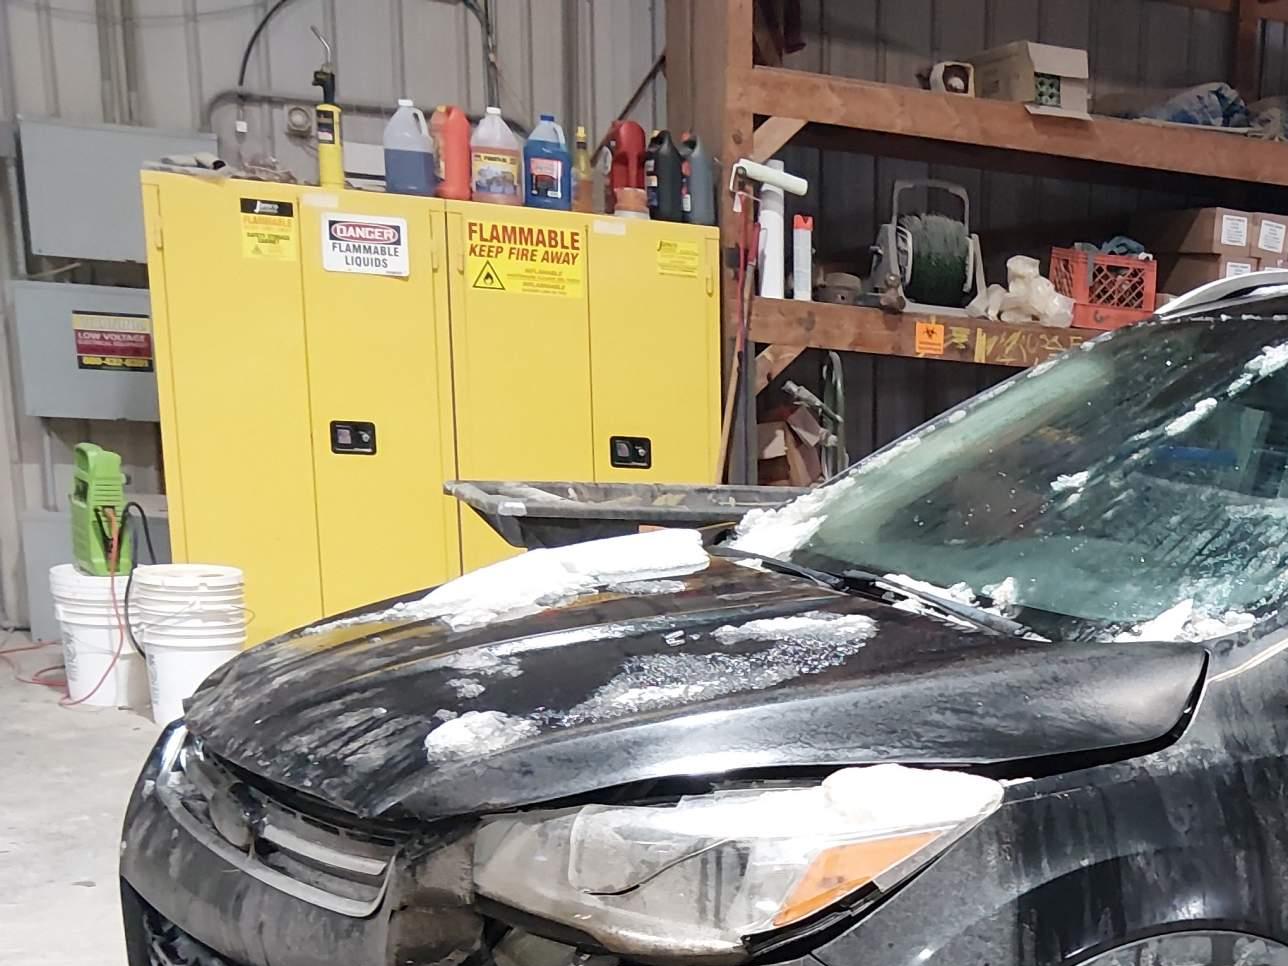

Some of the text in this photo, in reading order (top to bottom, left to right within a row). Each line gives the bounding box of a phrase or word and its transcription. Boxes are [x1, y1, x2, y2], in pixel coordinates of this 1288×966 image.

[337, 225, 394, 241] DANGER
[468, 222, 580, 250] FLAMMABLE
[332, 242, 400, 257] FLAMMABLE
[469, 243, 579, 266] KEEP FIRE AWAY
[345, 256, 388, 269] LIQUIDS
[78, 331, 146, 342] LOW VOLTAGE
